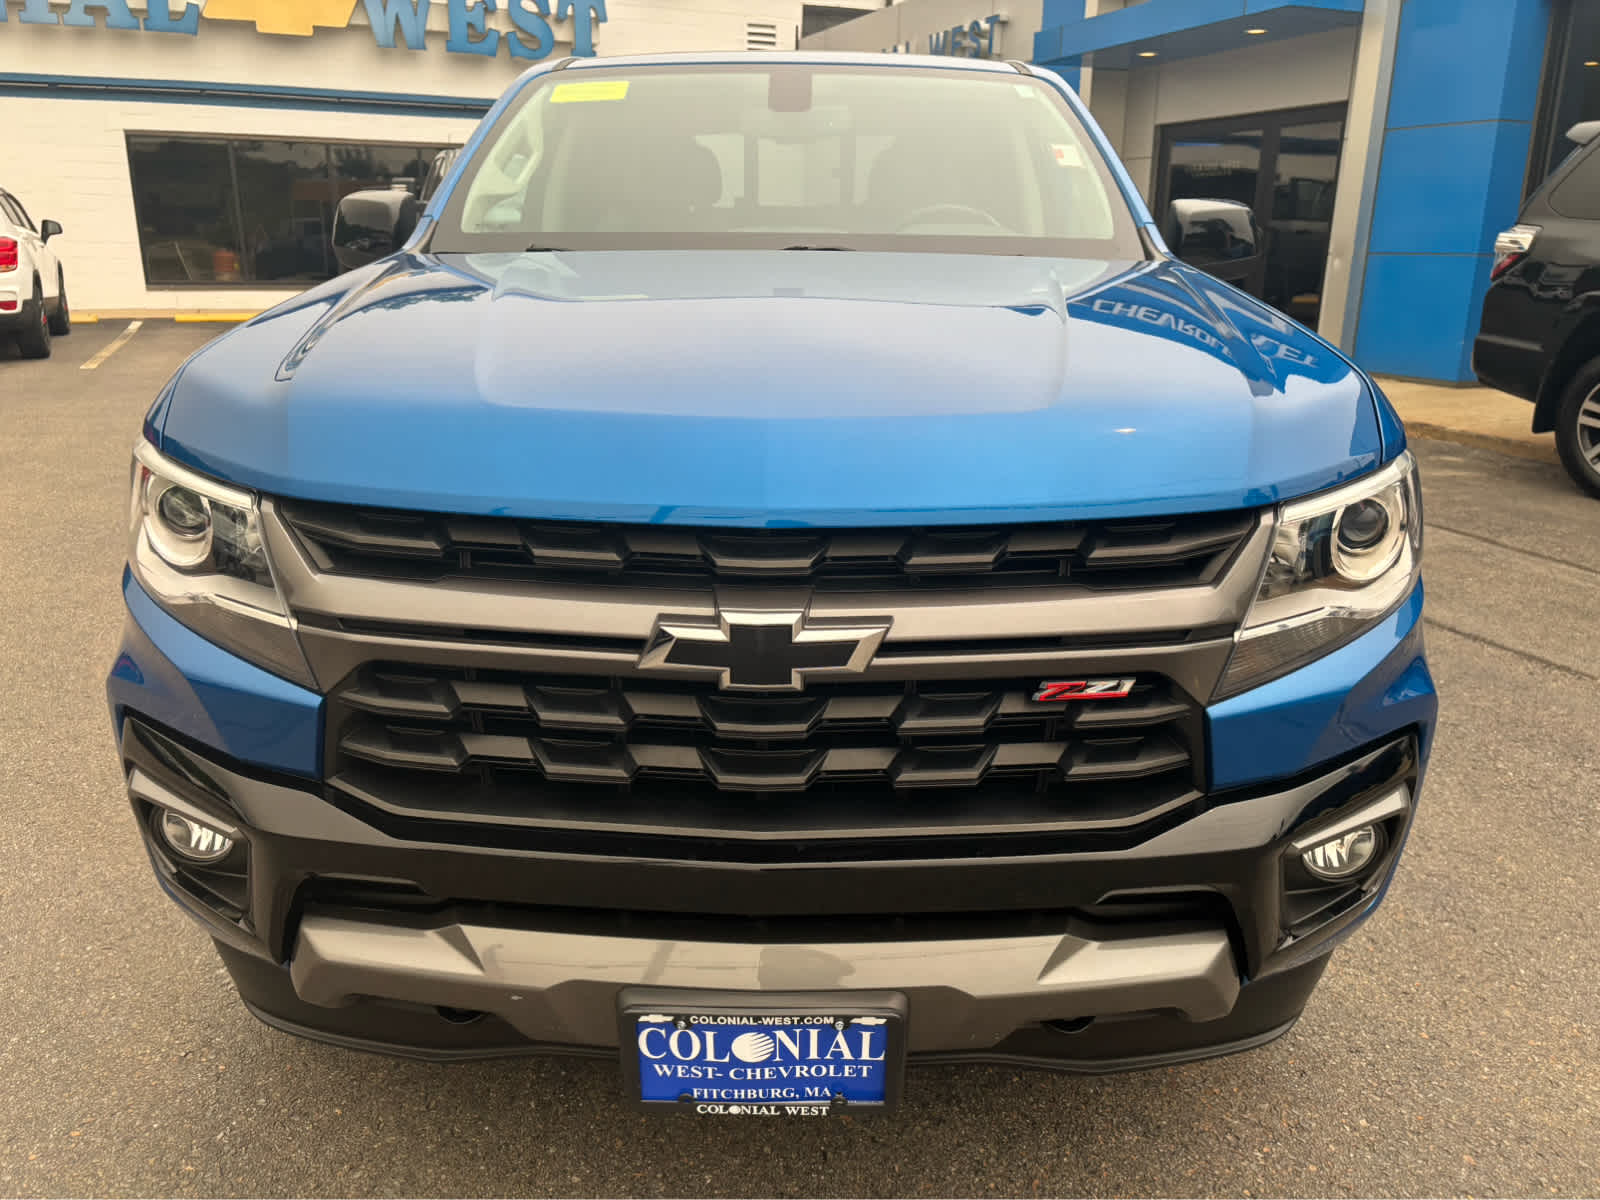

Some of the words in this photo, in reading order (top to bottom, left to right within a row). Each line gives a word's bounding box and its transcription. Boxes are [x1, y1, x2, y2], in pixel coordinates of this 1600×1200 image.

[363, 0, 608, 60] WEST
[929, 14, 1001, 59] WEST
[1032, 679, 1136, 702] Z71
[689, 1015, 835, 1026] COLONIAL-WEST.COM
[729, 1064, 873, 1080] CHEVROLET
[692, 1086, 800, 1100] FITCHBURG,
[804, 1086, 832, 1098] MA
[696, 1104, 780, 1117] COLONIAL
[786, 1105, 830, 1117] WEST
